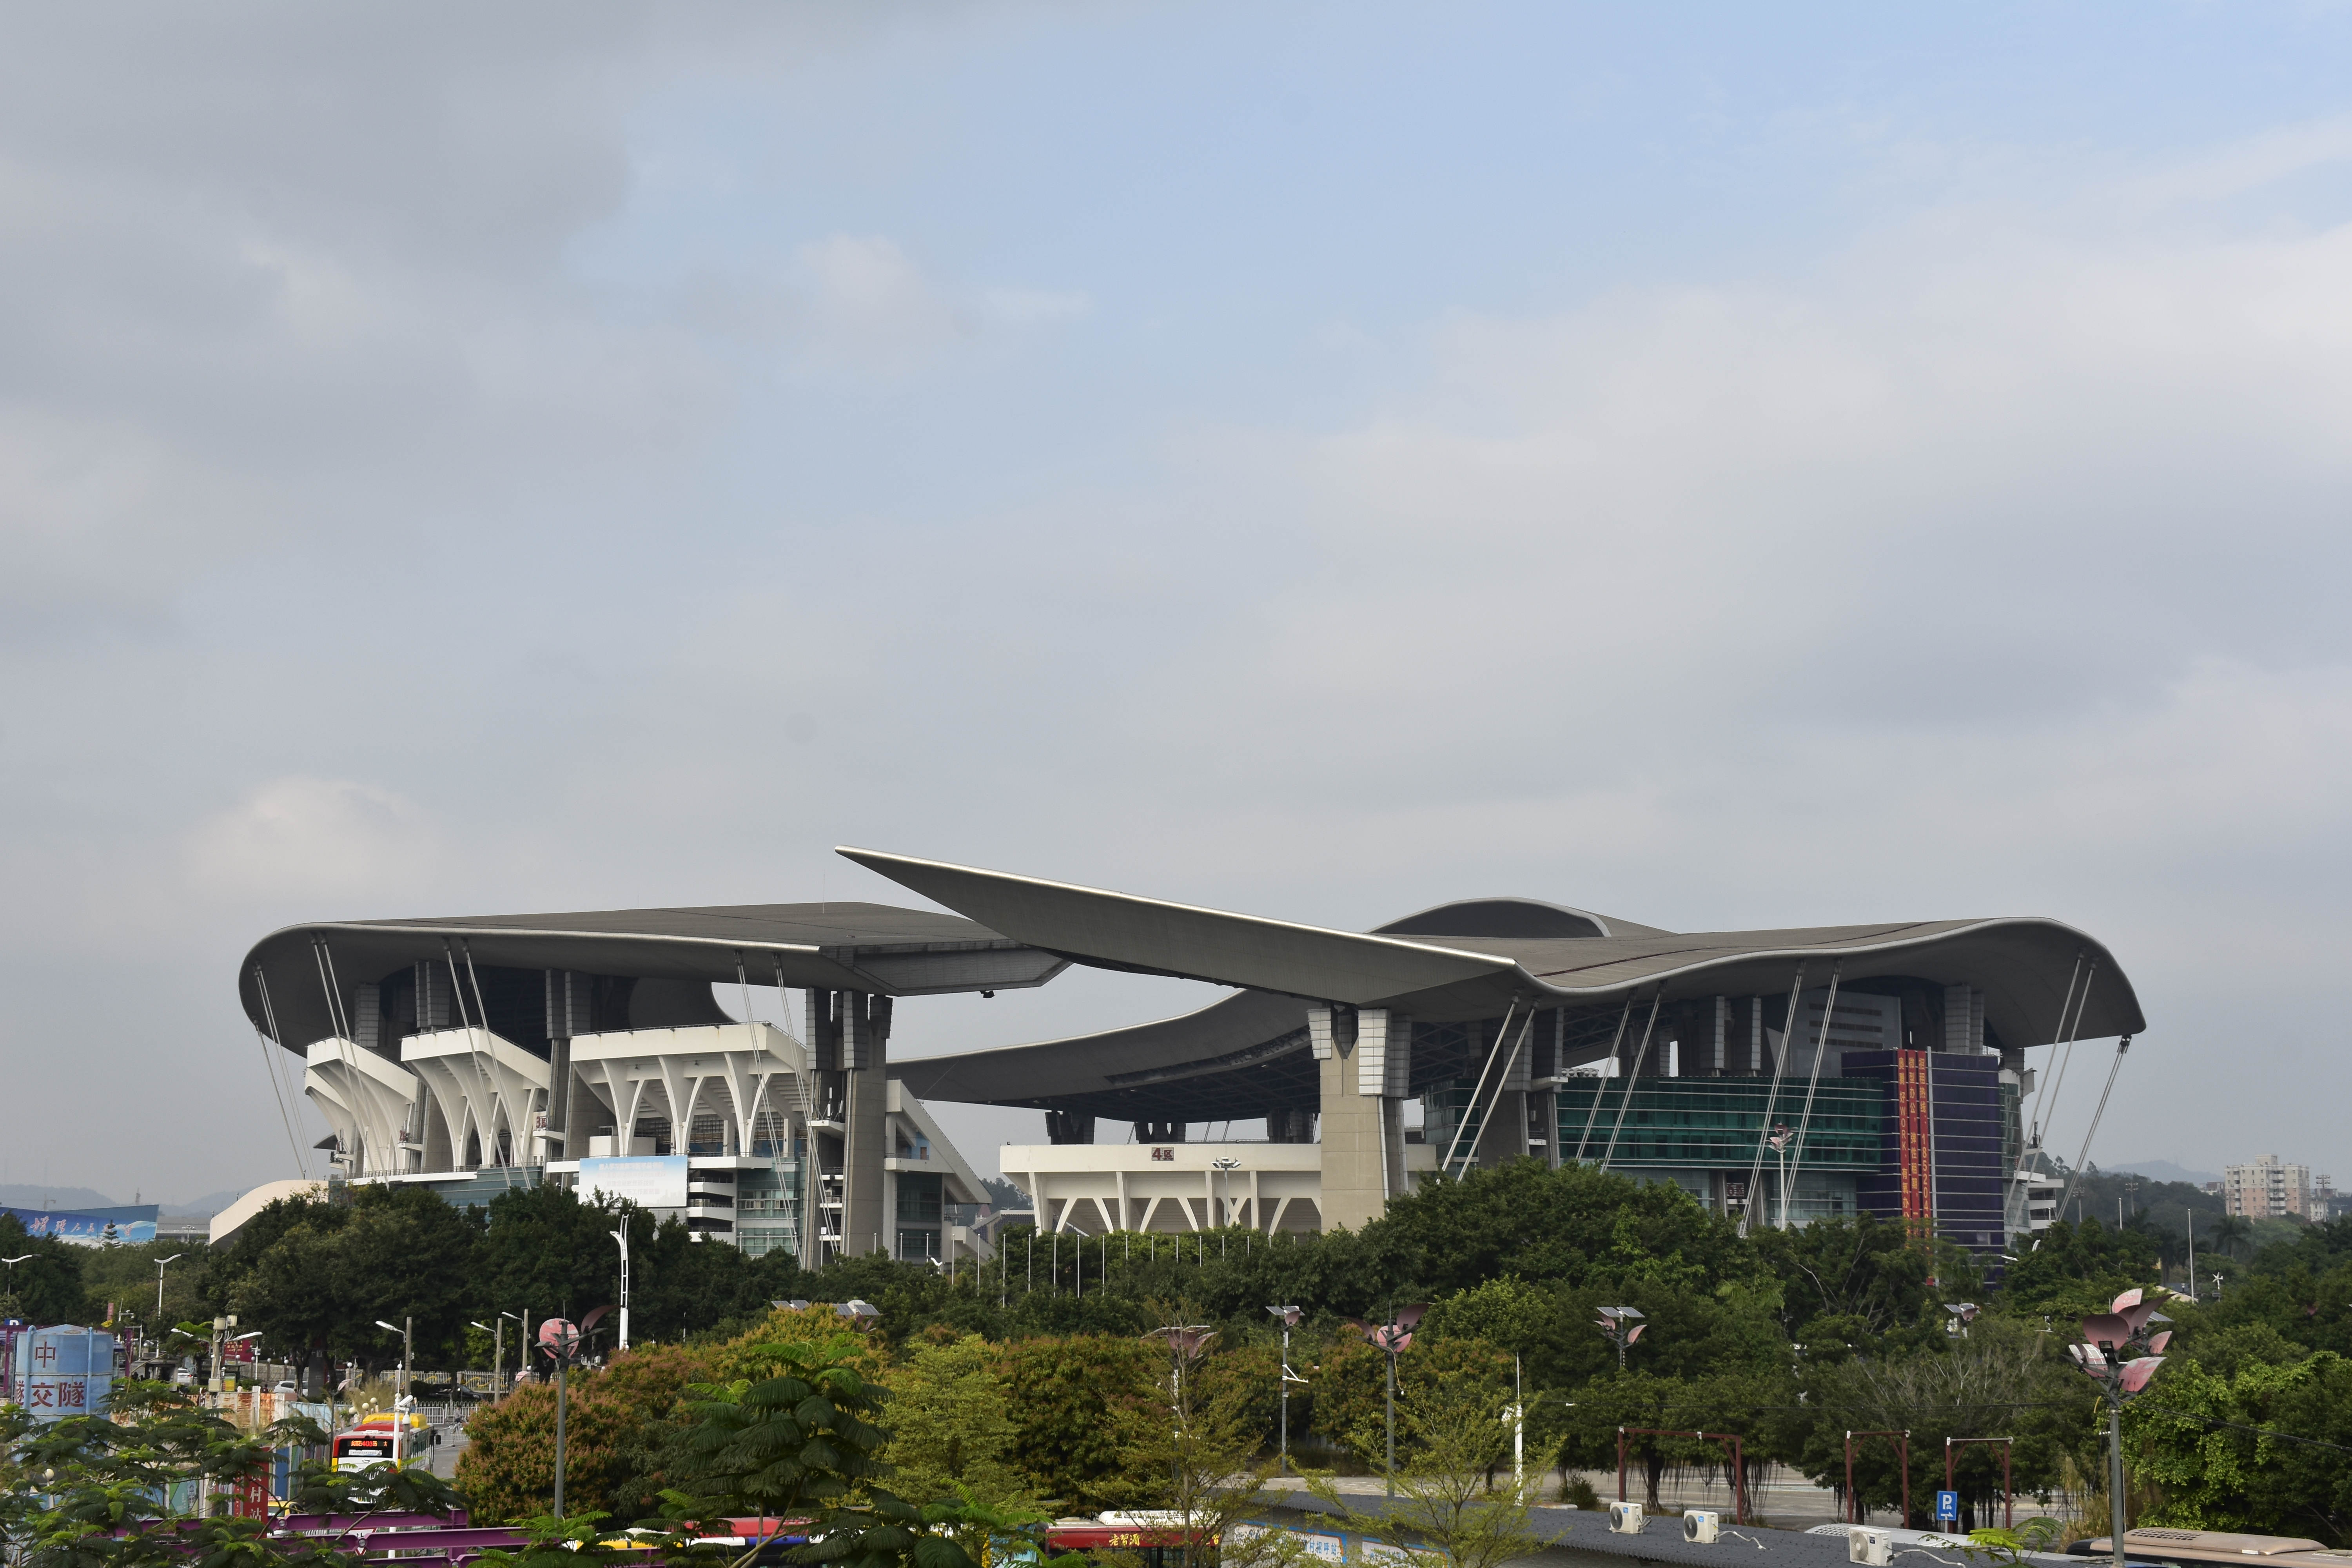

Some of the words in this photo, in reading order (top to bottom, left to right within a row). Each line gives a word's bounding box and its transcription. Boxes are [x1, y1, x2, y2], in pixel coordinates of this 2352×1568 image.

[1152, 1147, 1174, 1161] 4区
[35, 1341, 56, 1368] 中
[1943, 1494, 1952, 1510] P
[1303, 1539, 1337, 1556] 村招呼站
